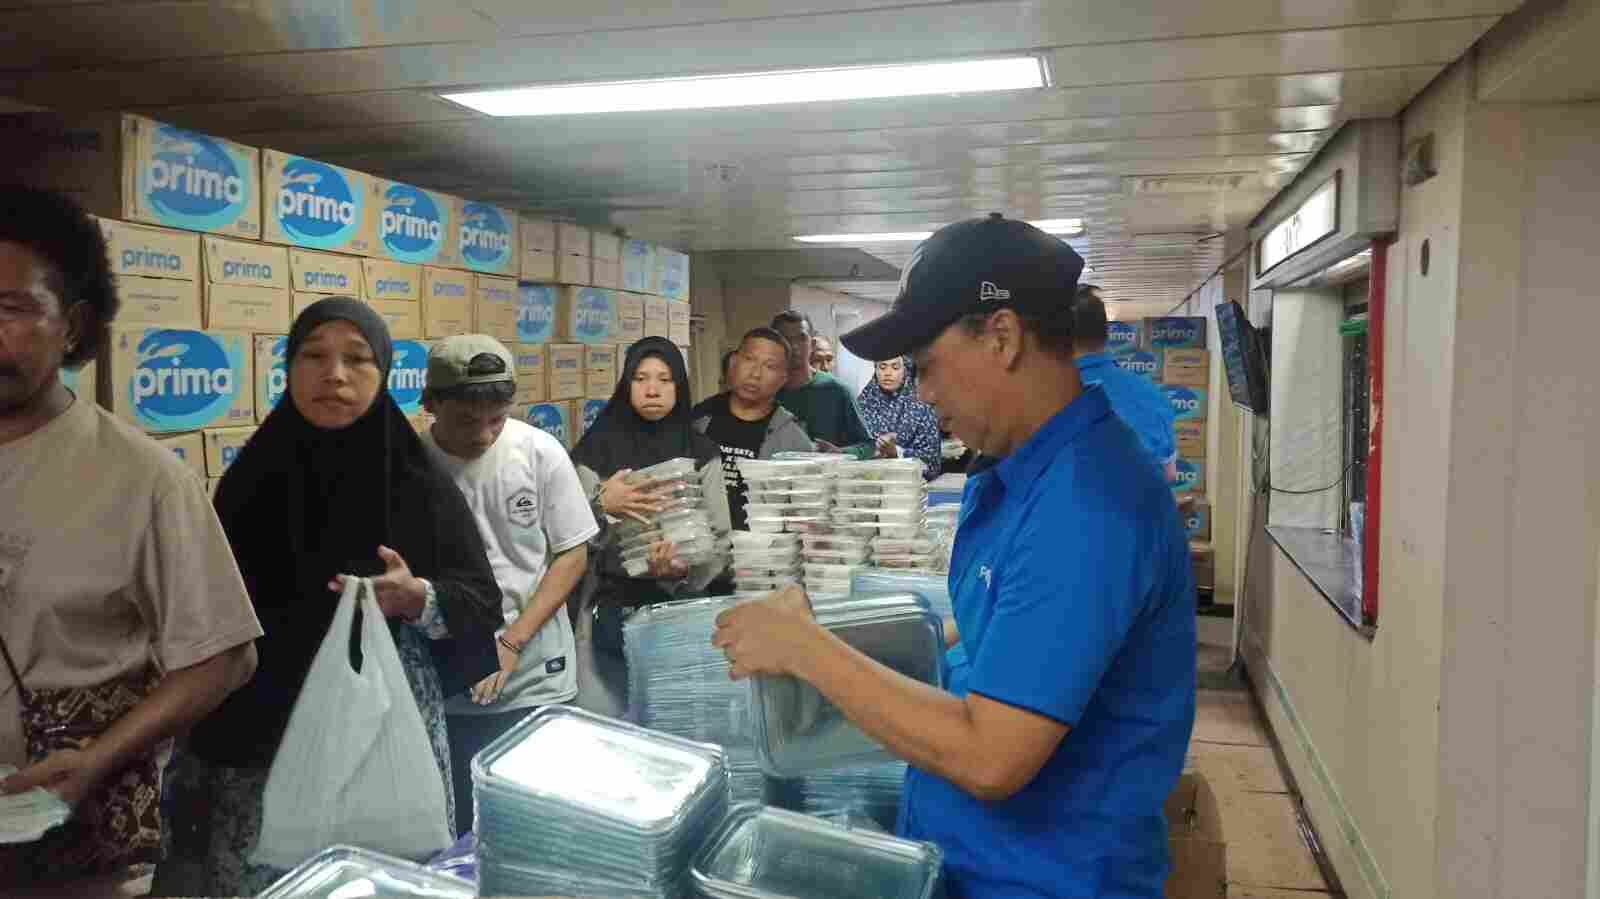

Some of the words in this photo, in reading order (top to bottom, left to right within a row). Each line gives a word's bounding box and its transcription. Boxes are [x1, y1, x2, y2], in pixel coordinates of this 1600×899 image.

[146, 157, 241, 203] prima
[277, 186, 355, 225] prima
[380, 208, 440, 241] prima
[459, 220, 509, 250] prima
[121, 246, 181, 271] prima
[223, 257, 272, 279] prima
[304, 267, 348, 288] prima
[133, 357, 233, 404] prima
